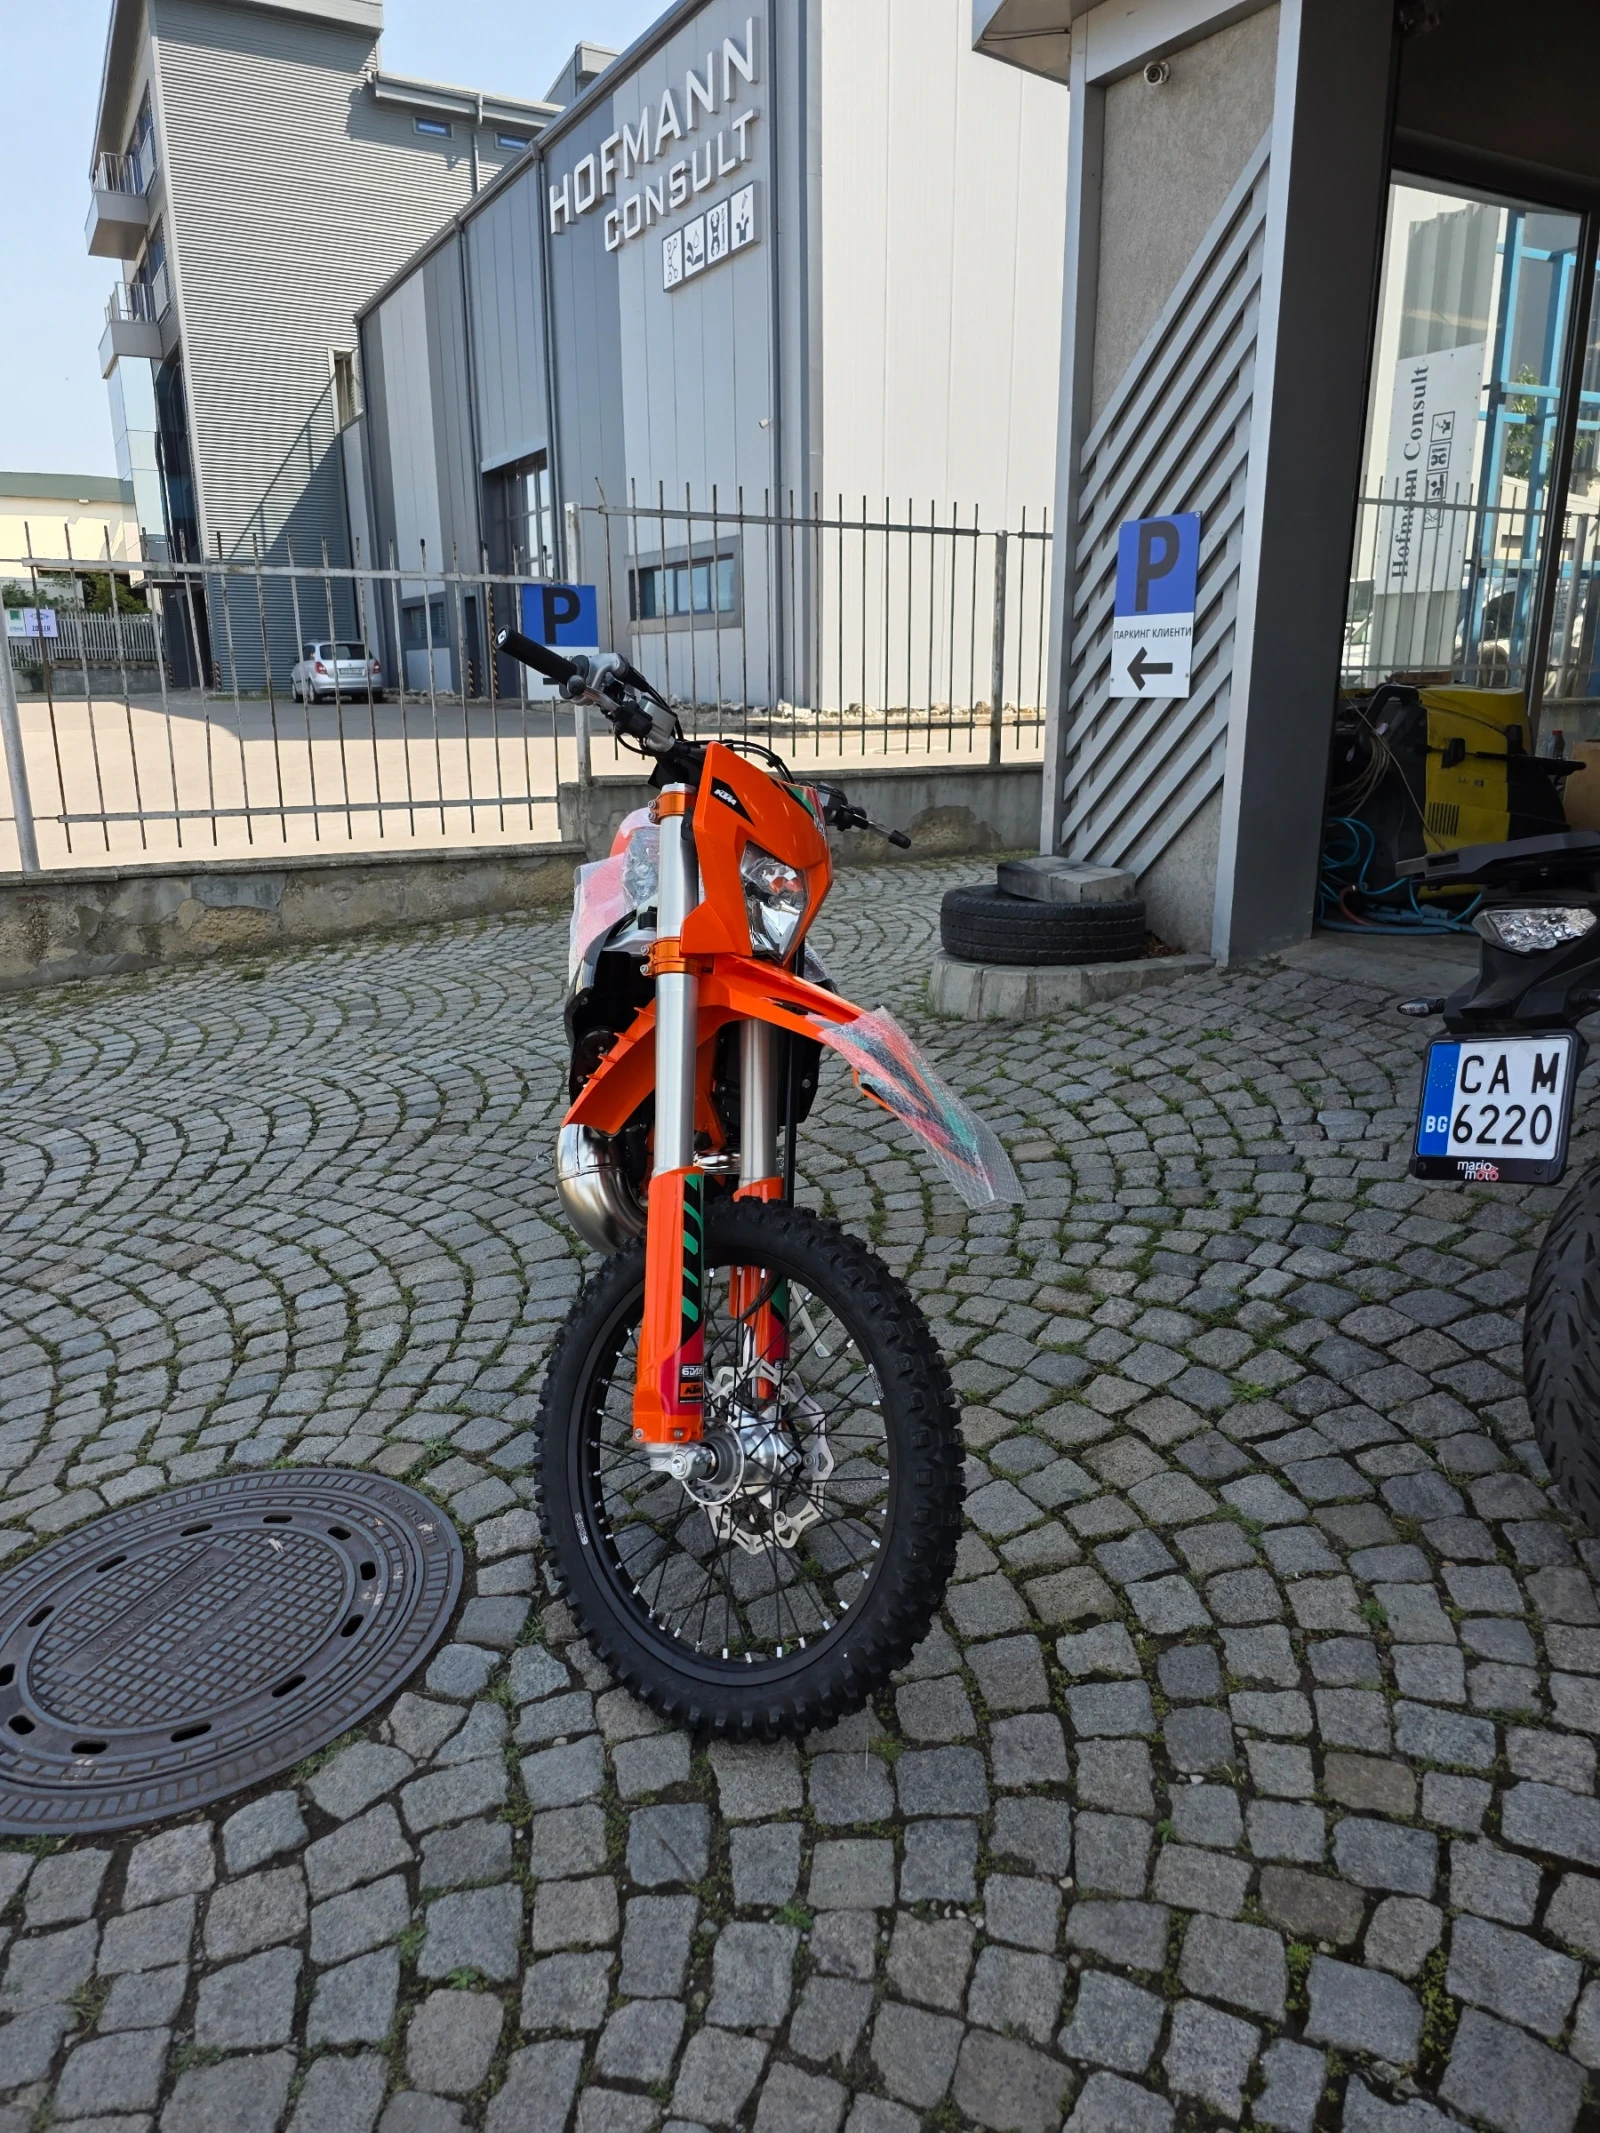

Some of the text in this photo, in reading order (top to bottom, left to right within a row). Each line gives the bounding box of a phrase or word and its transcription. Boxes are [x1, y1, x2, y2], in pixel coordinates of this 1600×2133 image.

[550, 17, 758, 234] HOFMANN
[604, 109, 759, 252] CONSULT
[1404, 365, 1429, 461] Consult
[1135, 521, 1180, 612] P
[542, 587, 581, 645] P
[1114, 626, 1192, 640] ПАРКИНГ КЛИЕНТИ
[714, 789, 738, 806] KTM
[1460, 1053, 1560, 1094] CA M
[1425, 1115, 1449, 1133] BG
[1453, 1104, 1552, 1145] 6220
[1457, 1160, 1492, 1171] mario
[1464, 1169, 1499, 1181] moto
[379, 1489, 439, 1545] ferocm
[87, 1560, 215, 1656] KANALIZACIJA
